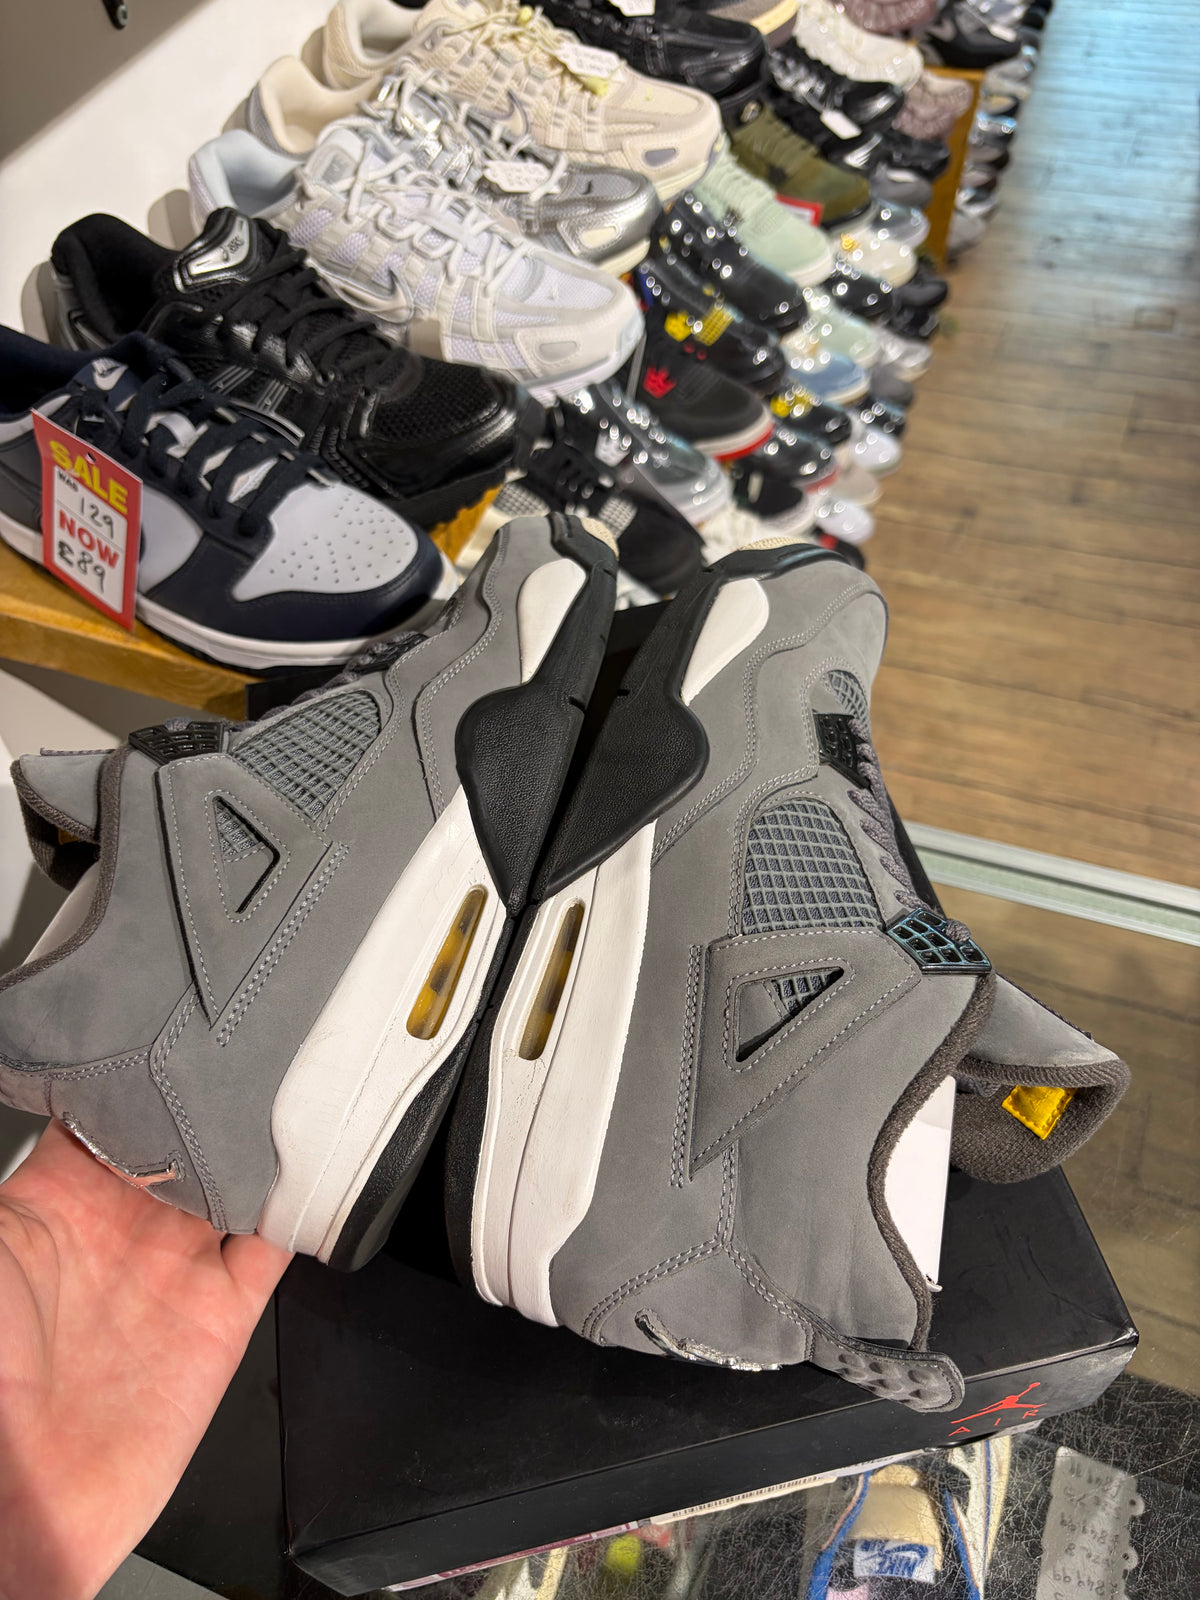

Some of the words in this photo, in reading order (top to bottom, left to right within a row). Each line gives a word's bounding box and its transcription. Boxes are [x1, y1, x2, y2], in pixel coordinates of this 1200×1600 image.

[49, 440, 128, 515] SALE
[58, 509, 120, 569] NOW
[81, 497, 114, 540] 129
[58, 540, 106, 594] £89
[948, 1408, 1040, 1437] AIR
